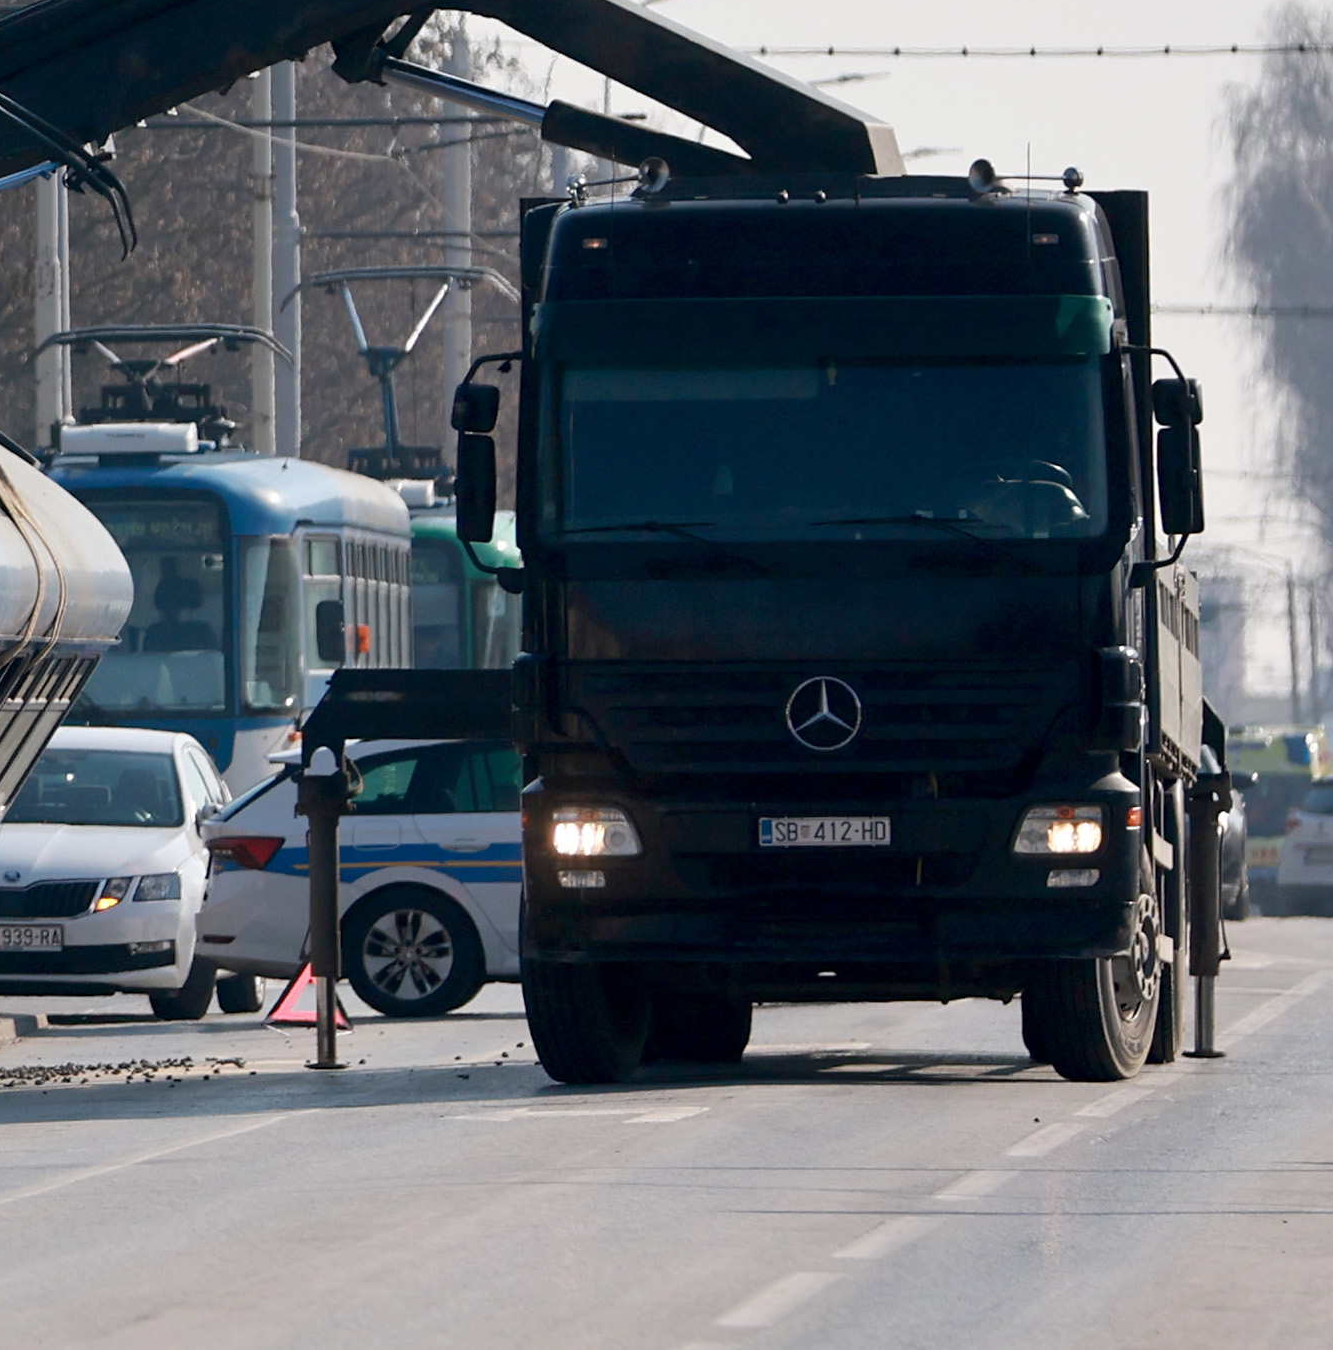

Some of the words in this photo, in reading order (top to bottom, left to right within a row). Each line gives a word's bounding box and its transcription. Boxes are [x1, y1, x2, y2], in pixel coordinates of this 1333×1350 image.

[775, 821, 798, 842] SB
[814, 821, 886, 841] 412-HD
[2, 928, 60, 946] 939-RA
